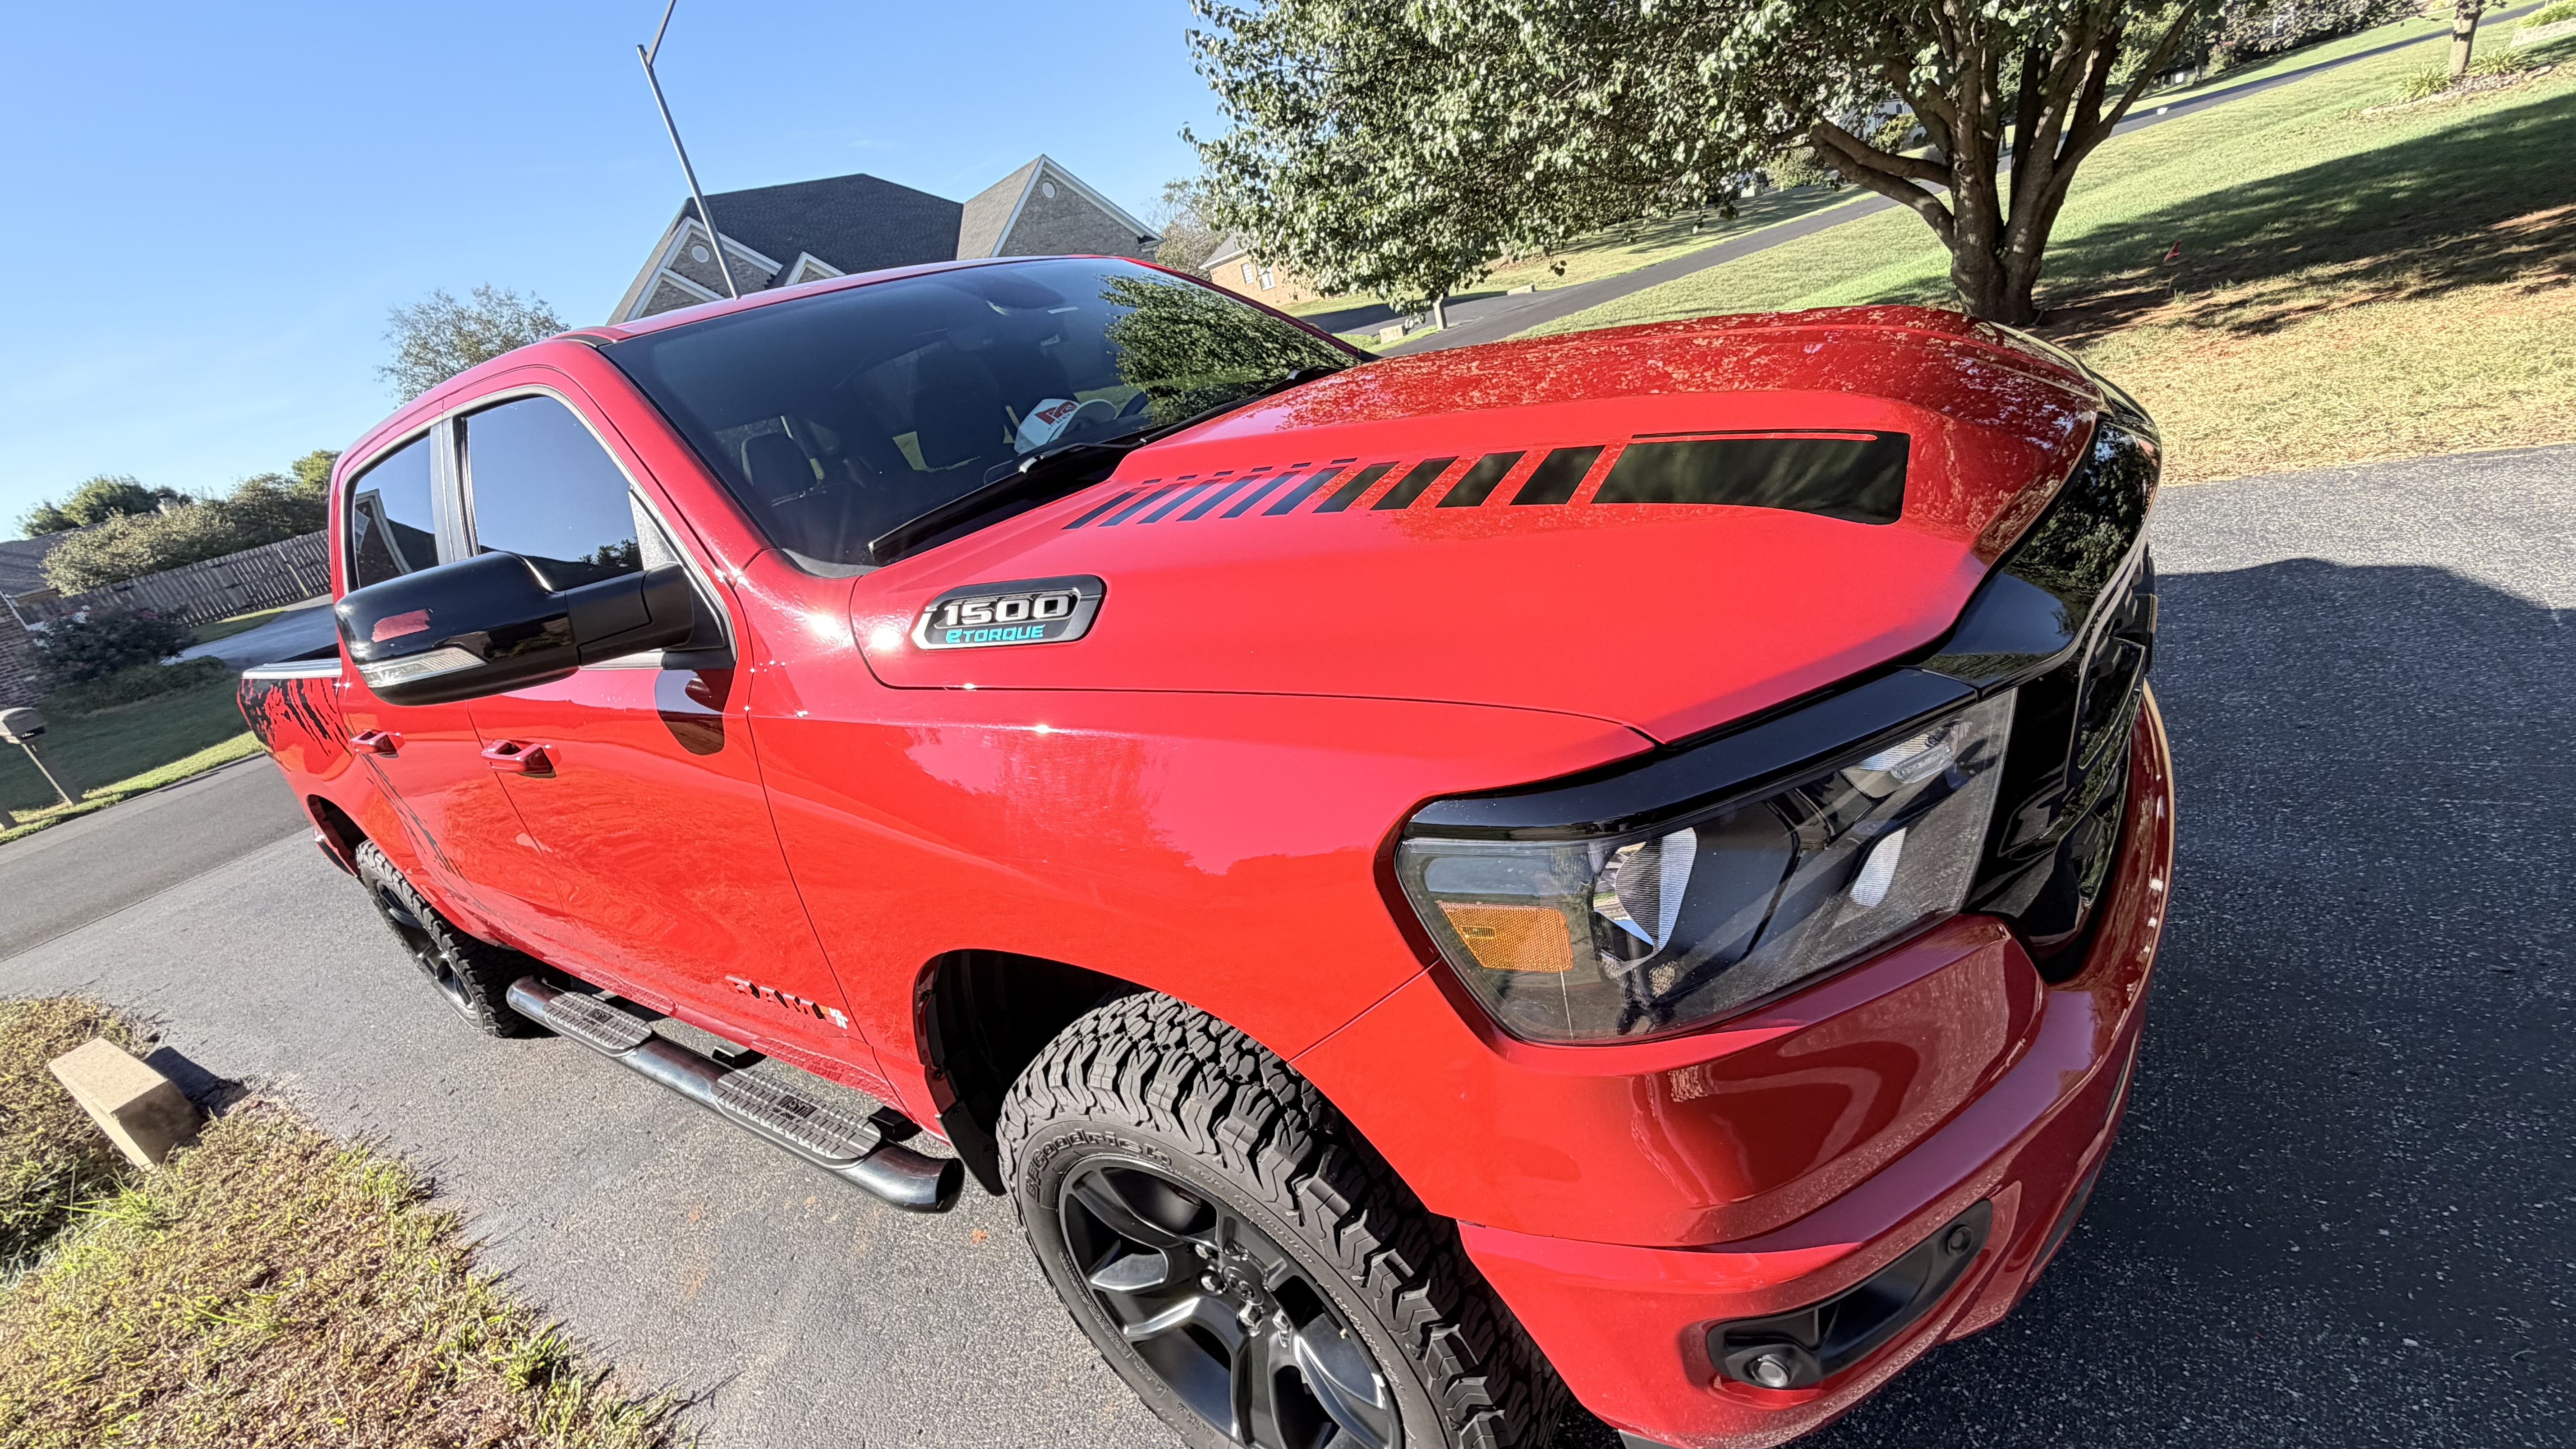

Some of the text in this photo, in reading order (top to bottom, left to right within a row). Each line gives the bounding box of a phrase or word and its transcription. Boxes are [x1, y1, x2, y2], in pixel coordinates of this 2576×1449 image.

[943, 594, 1070, 626] 1500
[725, 974, 825, 1020] RAM
[1025, 1127, 1173, 1203] BFGoodrich
